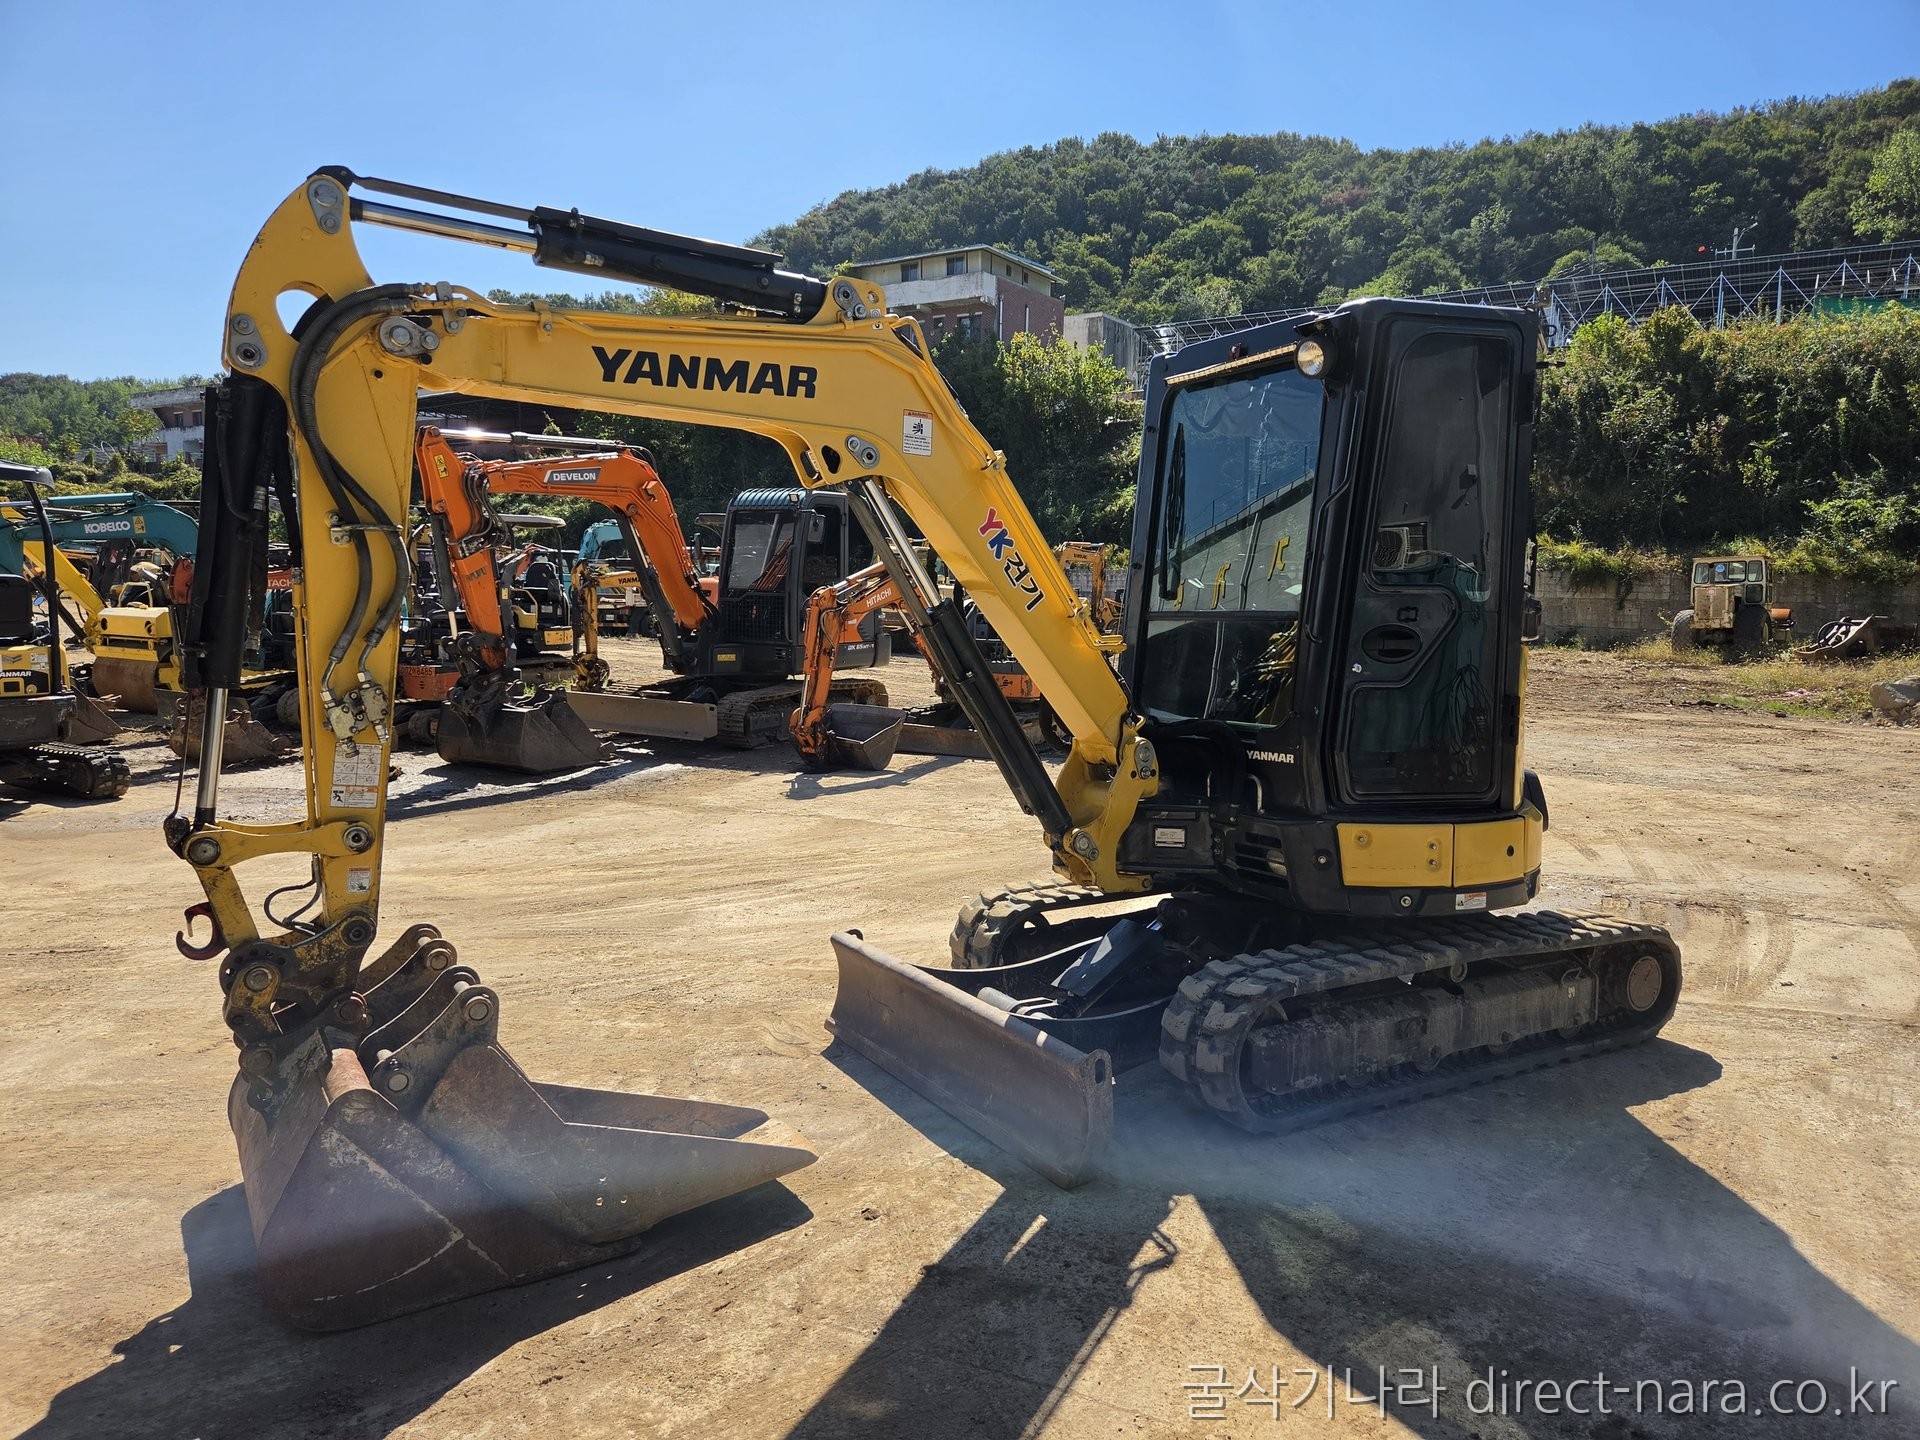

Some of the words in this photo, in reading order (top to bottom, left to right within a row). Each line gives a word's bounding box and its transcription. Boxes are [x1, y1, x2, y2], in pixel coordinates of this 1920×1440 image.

[591, 346, 818, 399] YANMAR
[553, 472, 597, 481] DEVELON
[84, 521, 131, 533] KOBELCO
[866, 588, 892, 608] HITACHI
[1246, 750, 1295, 764] YANMAR
